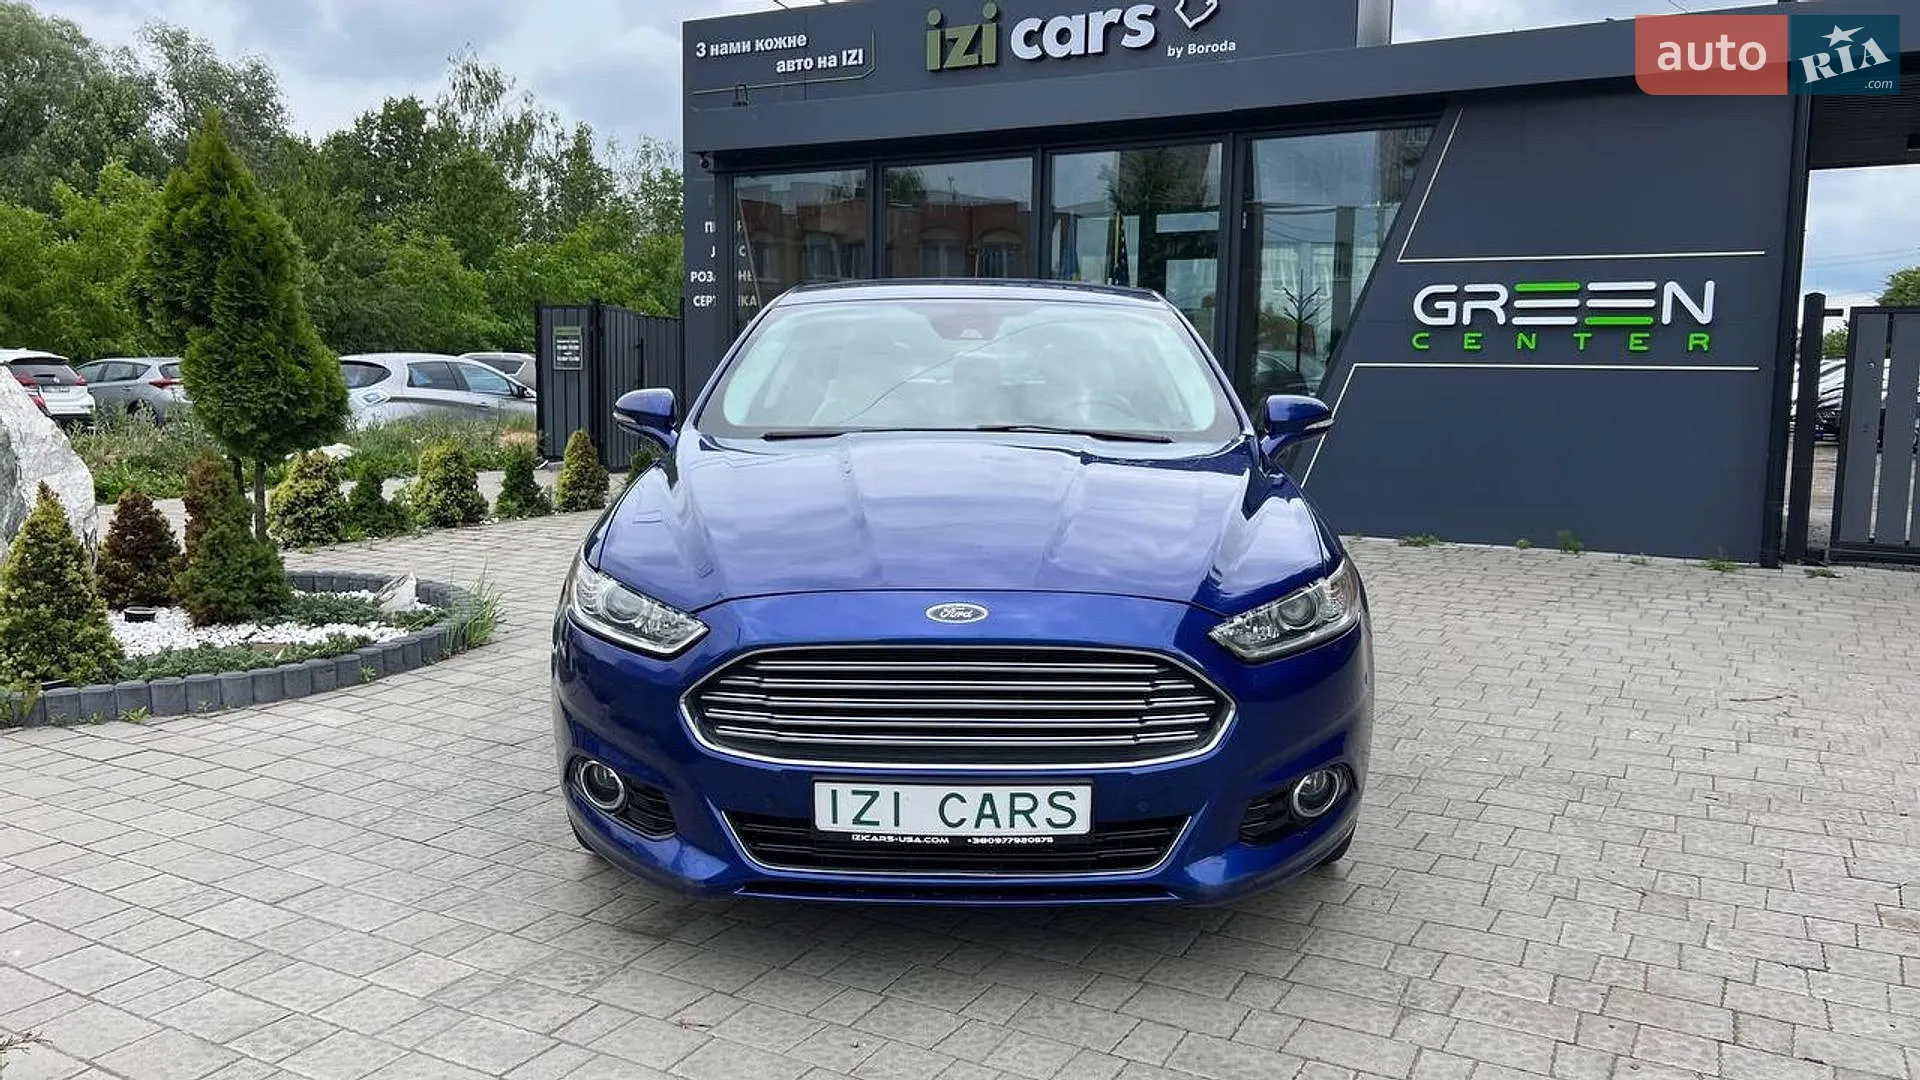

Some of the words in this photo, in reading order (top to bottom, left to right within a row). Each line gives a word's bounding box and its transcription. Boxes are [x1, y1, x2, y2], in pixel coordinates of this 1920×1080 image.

[710, 40, 751, 56] нами
[755, 34, 807, 51] кожне
[926, 2, 998, 71] izi
[1010, 4, 1156, 60] cars
[776, 58, 813, 73] авто
[818, 55, 837, 68] на
[842, 48, 864, 66] IZI
[1167, 44, 1184, 58] by
[1187, 40, 1237, 55] Boroda
[1413, 280, 1716, 326] GREEN
[1412, 332, 1711, 351] CENTER
[940, 607, 974, 618] Ford
[831, 789, 900, 827] IZI
[938, 790, 1078, 829] CARS
